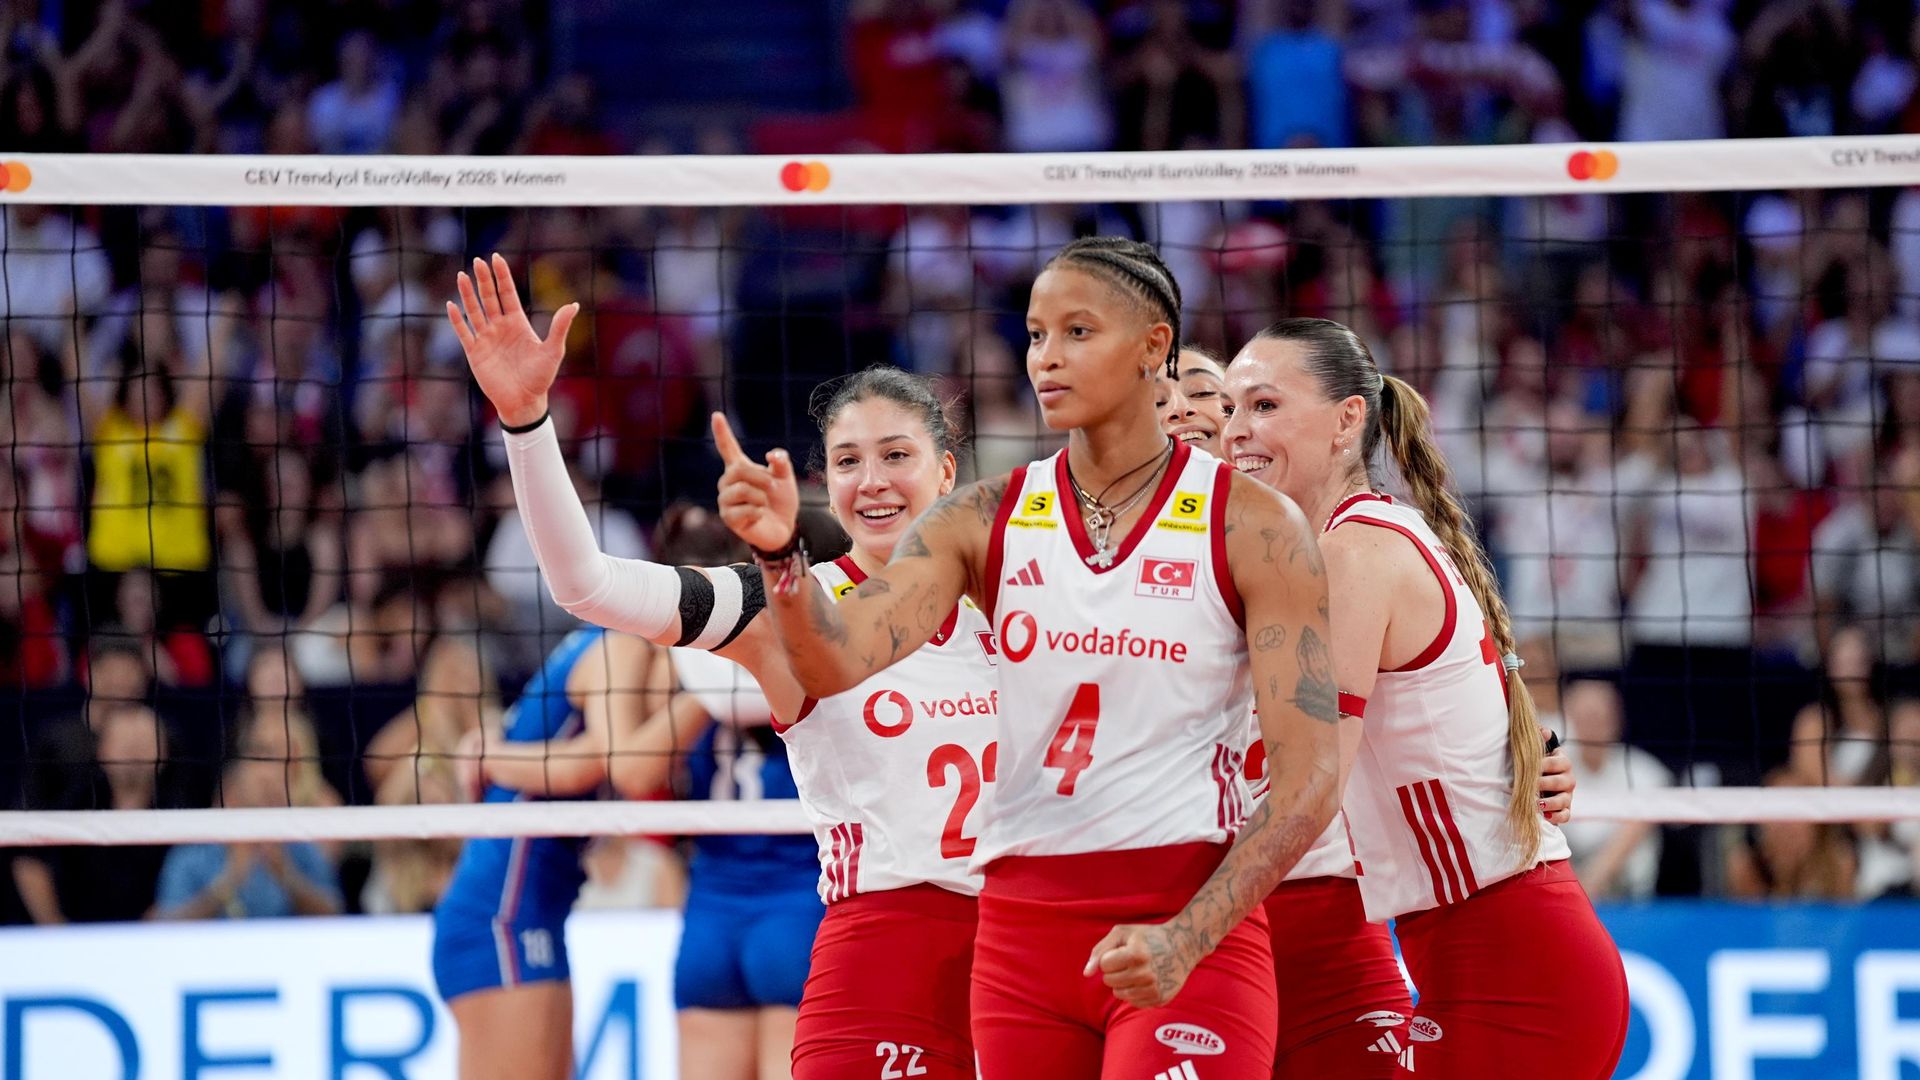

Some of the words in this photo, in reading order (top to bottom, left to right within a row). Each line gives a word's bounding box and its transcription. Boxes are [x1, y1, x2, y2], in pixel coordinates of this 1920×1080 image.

[1830, 148, 1868, 167] CEV
[244, 168, 280, 185] CEV
[286, 167, 358, 189] Trendyol
[363, 168, 451, 189] EuroVolley
[502, 169, 566, 185] Women
[1043, 165, 1076, 181] CEV
[1158, 163, 1243, 181] EuroVolley
[1295, 161, 1359, 176] Women
[1030, 496, 1047, 511] S
[1180, 498, 1198, 514] S
[1150, 585, 1180, 596] TUR
[1046, 627, 1187, 663] vodafone
[920, 690, 998, 719] vodaf
[1043, 683, 1100, 796] 4
[1162, 1028, 1219, 1049] gratis
[876, 1041, 927, 1080] 22
